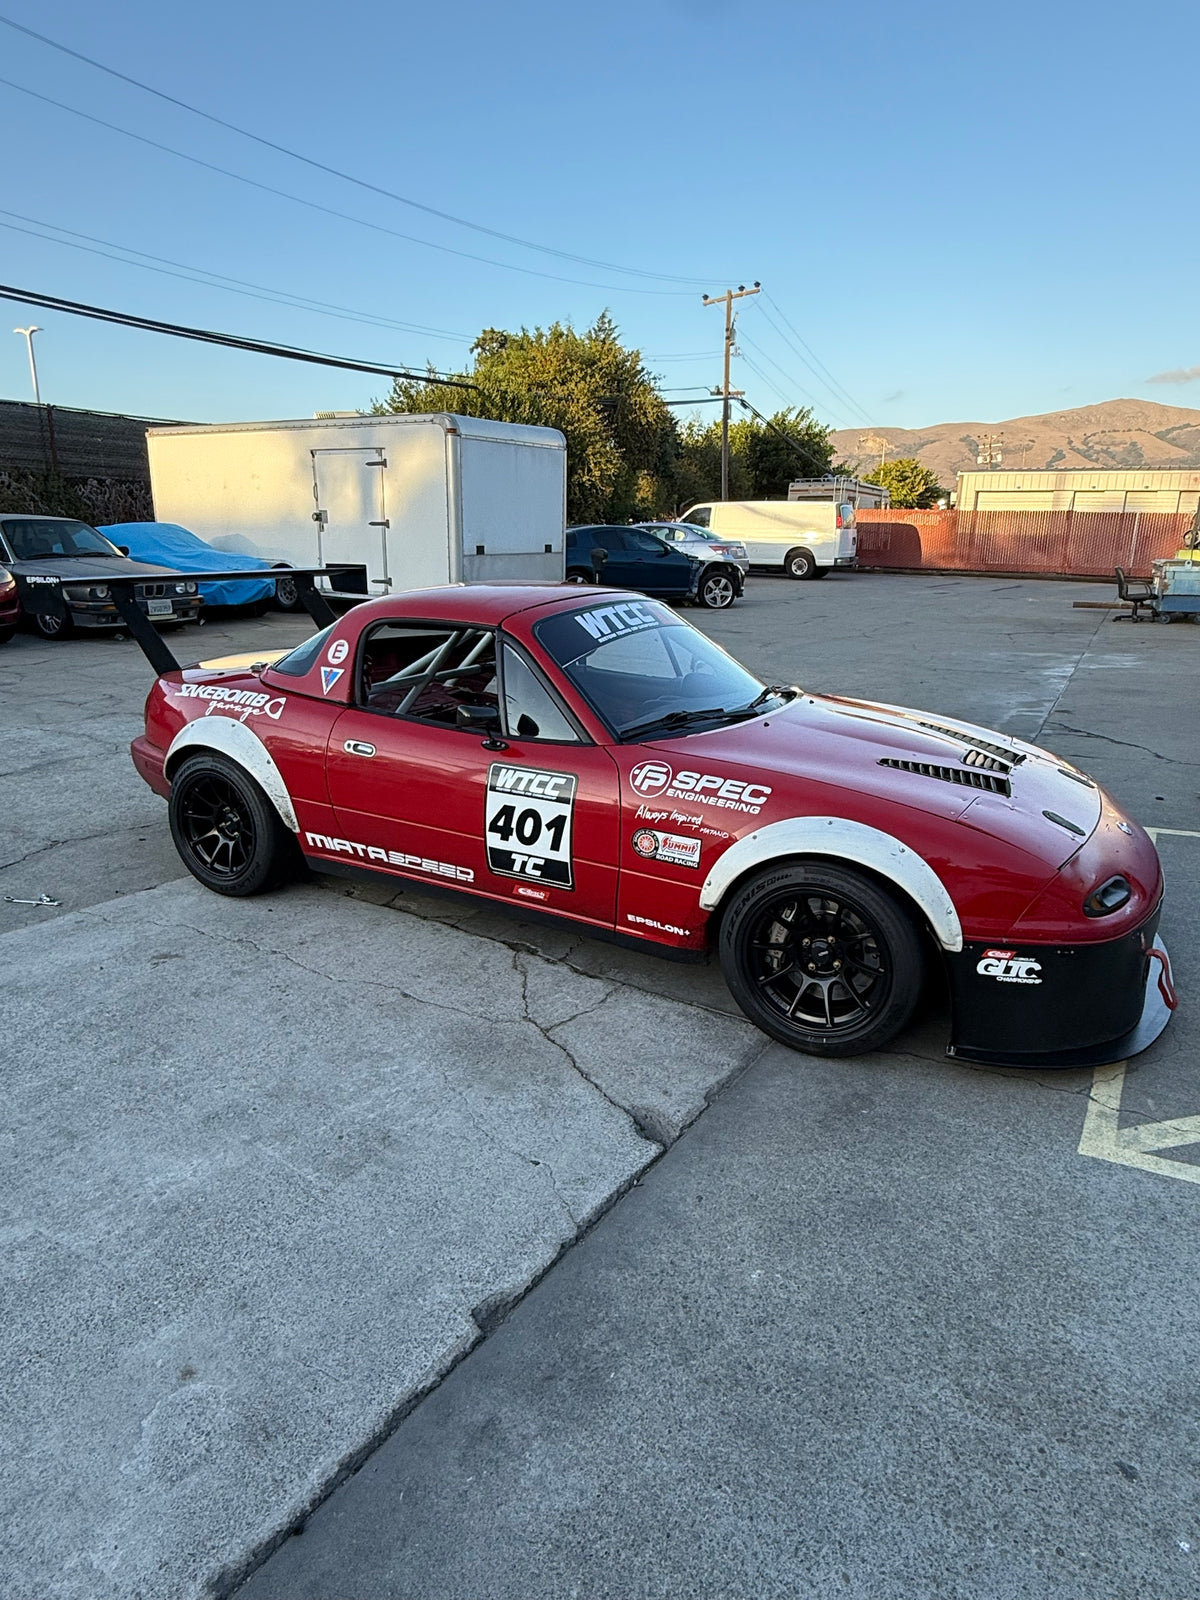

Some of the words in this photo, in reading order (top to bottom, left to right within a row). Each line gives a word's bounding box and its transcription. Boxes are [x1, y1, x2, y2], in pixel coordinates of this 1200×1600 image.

[26, 576, 60, 584] EPSILON+
[574, 602, 656, 639] WTCC
[331, 643, 345, 659] E
[175, 684, 271, 707] SAKEBOMB
[205, 699, 267, 723] garage
[495, 768, 567, 797] WTCC
[671, 770, 772, 805] SPEC
[665, 788, 761, 815] ENGINEERING
[635, 803, 669, 823] Always
[669, 809, 703, 826] Inspired
[488, 804, 568, 852] 401
[511, 853, 545, 876] TC
[655, 853, 674, 862] ROAD
[674, 858, 698, 868] RACING
[627, 914, 690, 936] EPSILON+
